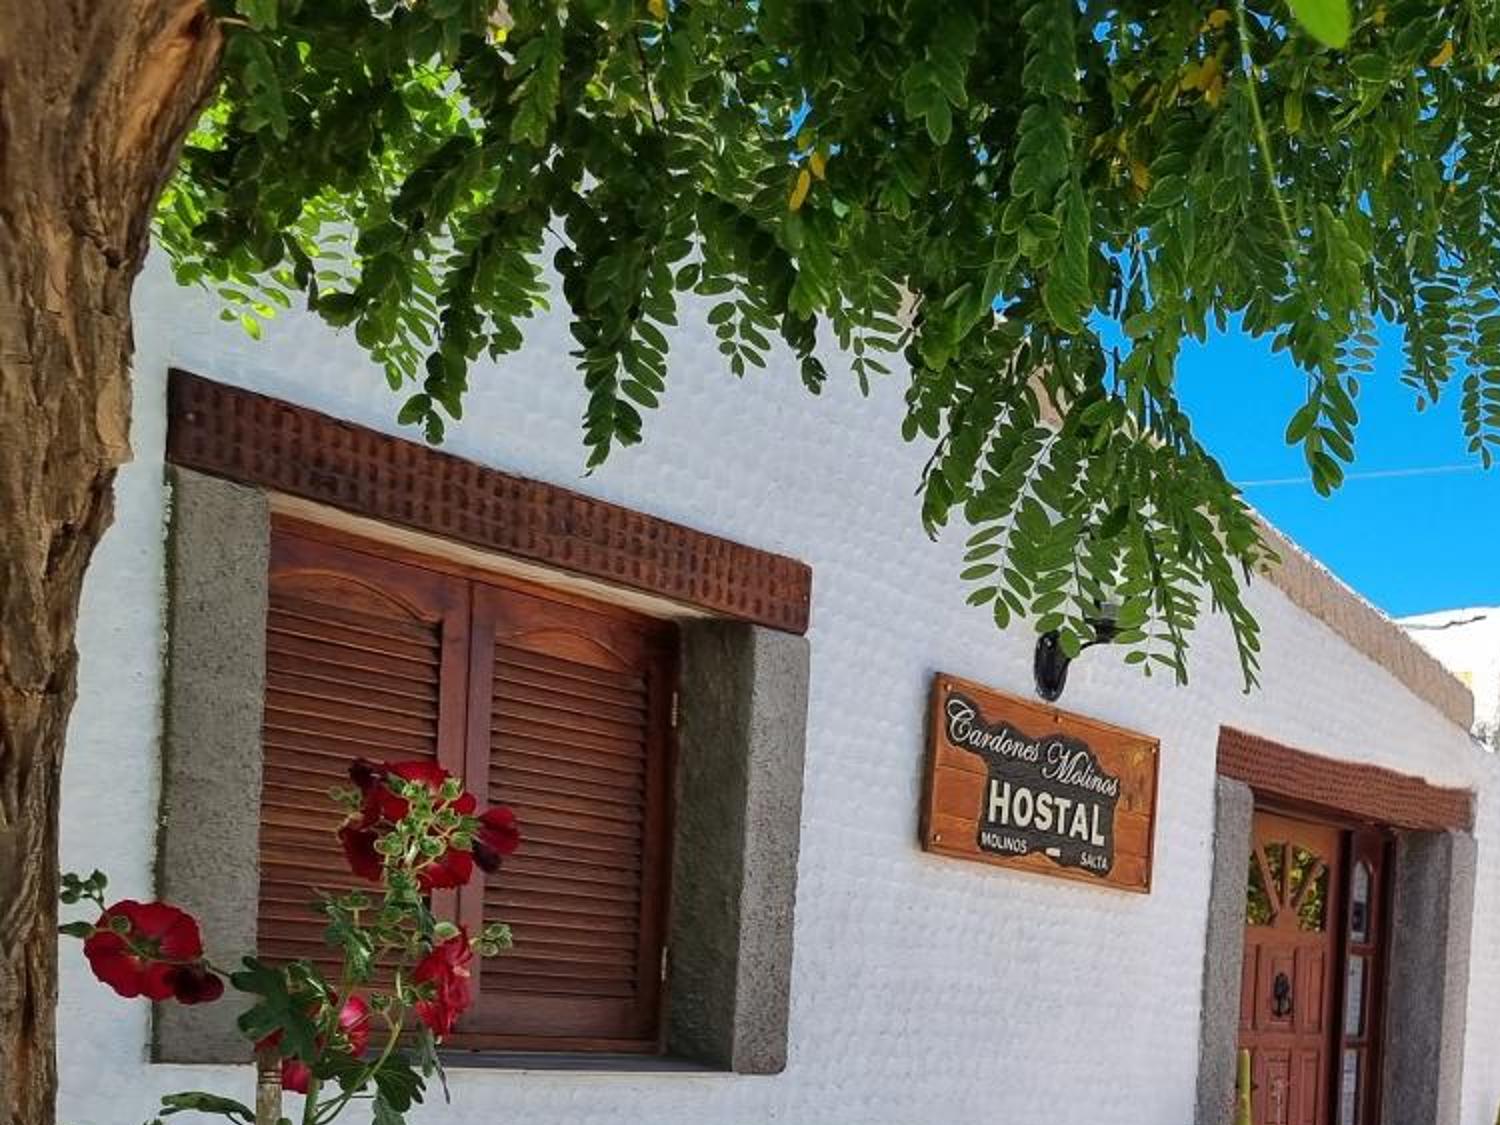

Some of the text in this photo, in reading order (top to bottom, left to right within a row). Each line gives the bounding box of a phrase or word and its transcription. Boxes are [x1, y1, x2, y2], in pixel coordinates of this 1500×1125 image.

[947, 698, 1119, 797] Cardones Molinos
[989, 779, 1105, 847] HOSTAL
[981, 832, 1028, 854] MOLINOS
[1080, 852, 1108, 870] SALTA
